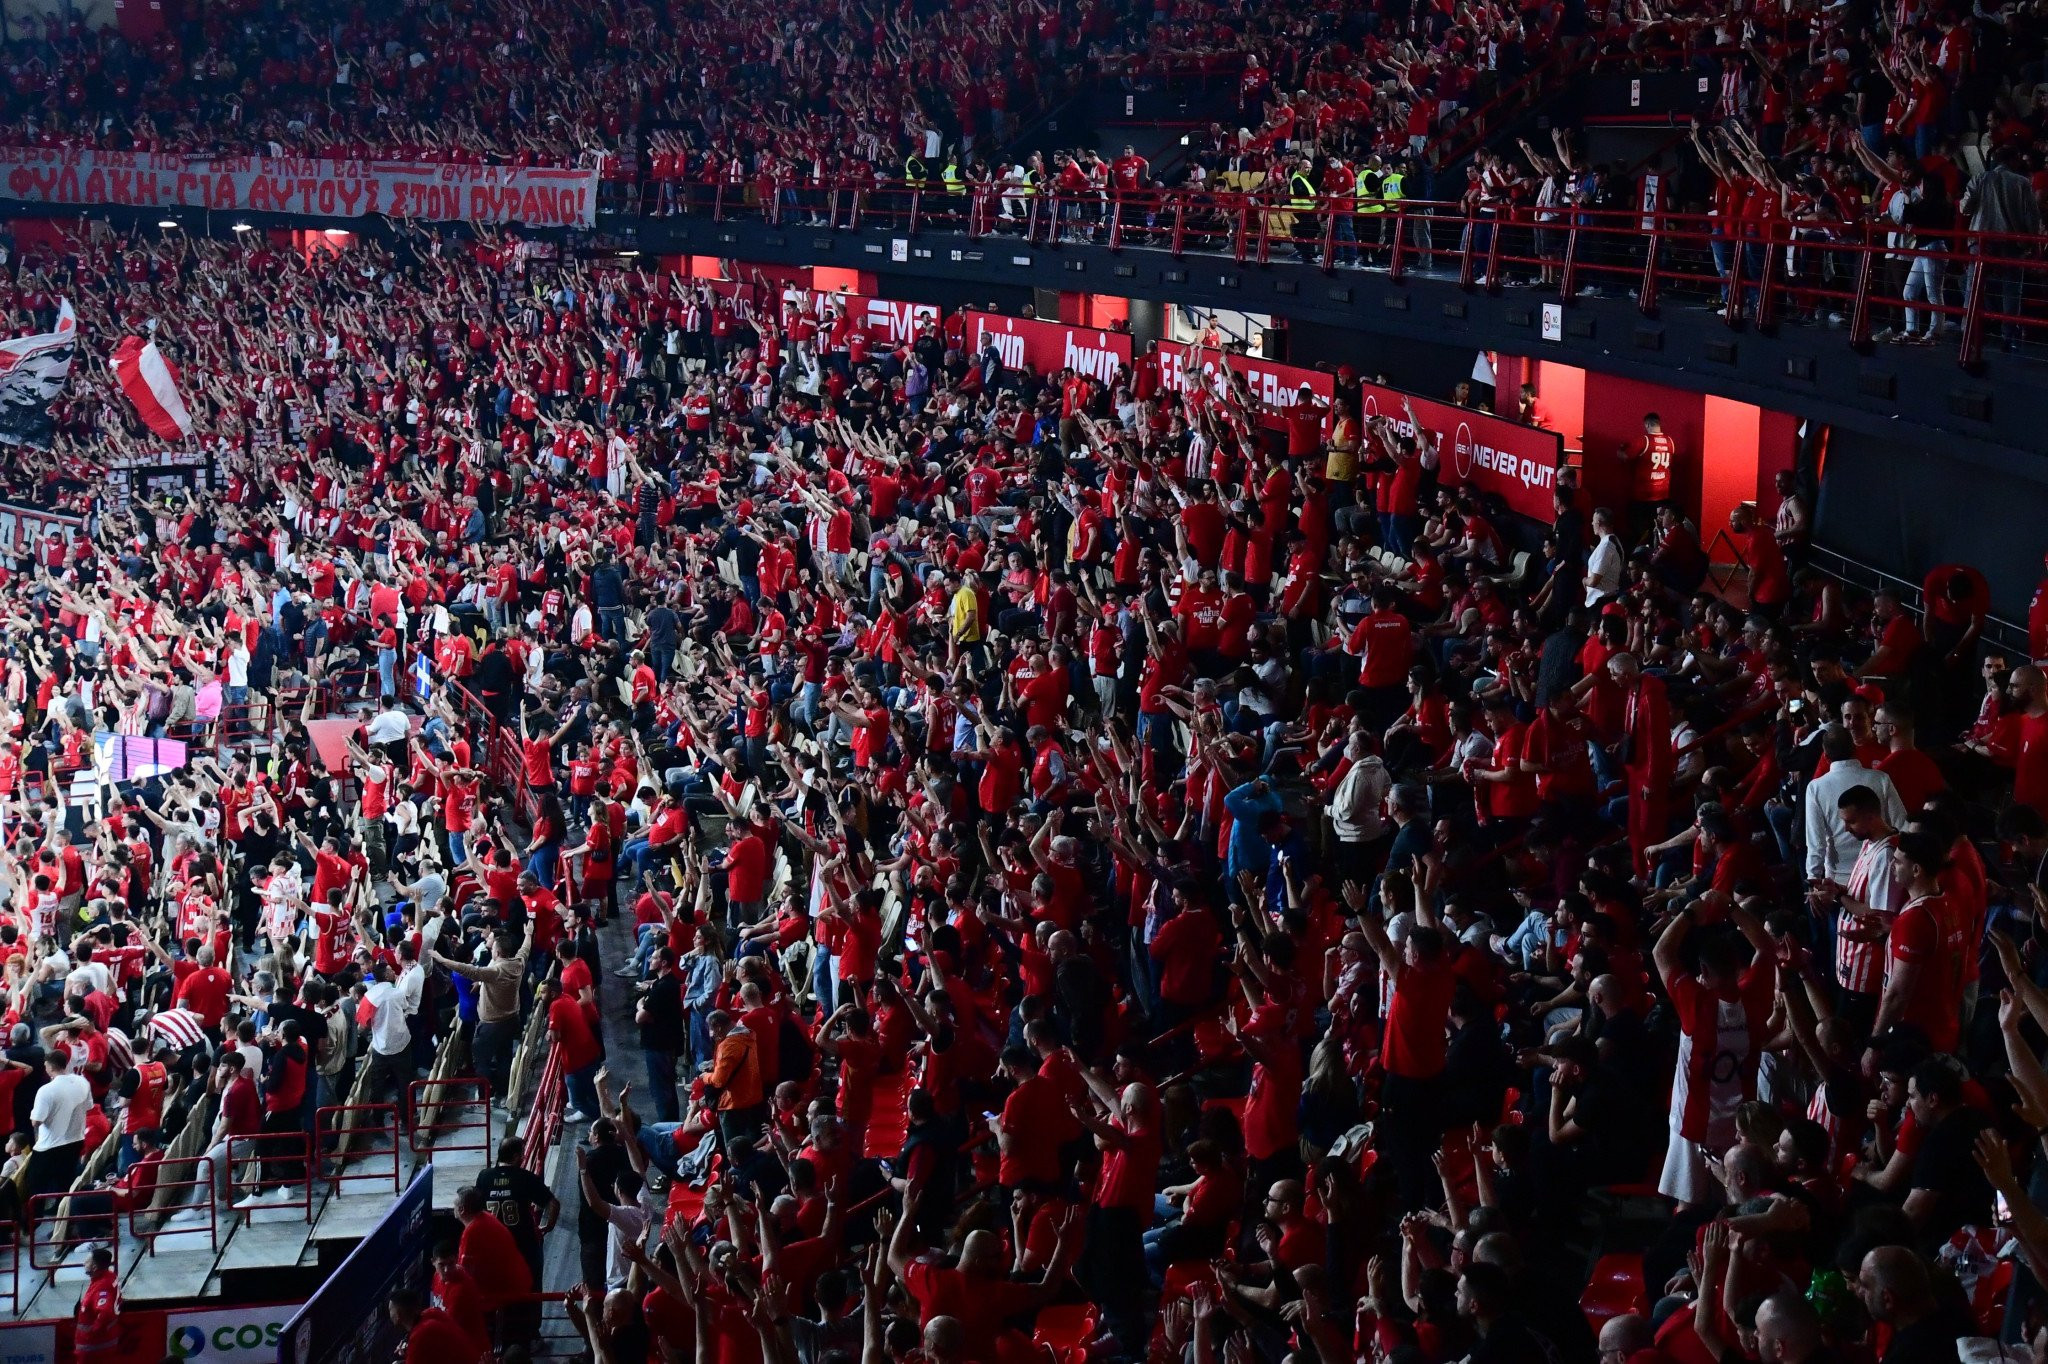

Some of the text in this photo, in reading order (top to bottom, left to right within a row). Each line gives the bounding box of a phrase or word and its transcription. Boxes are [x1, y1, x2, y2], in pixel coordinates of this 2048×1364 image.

[249, 175, 379, 216] ΑΥΤΟΥΣ
[389, 182, 460, 219] ΣΤΟΝ
[1064, 330, 1120, 386] bwin
[1473, 443, 1555, 490] NEVER QUIT
[1651, 452, 1670, 470] 94
[486, 1200, 520, 1226] 78
